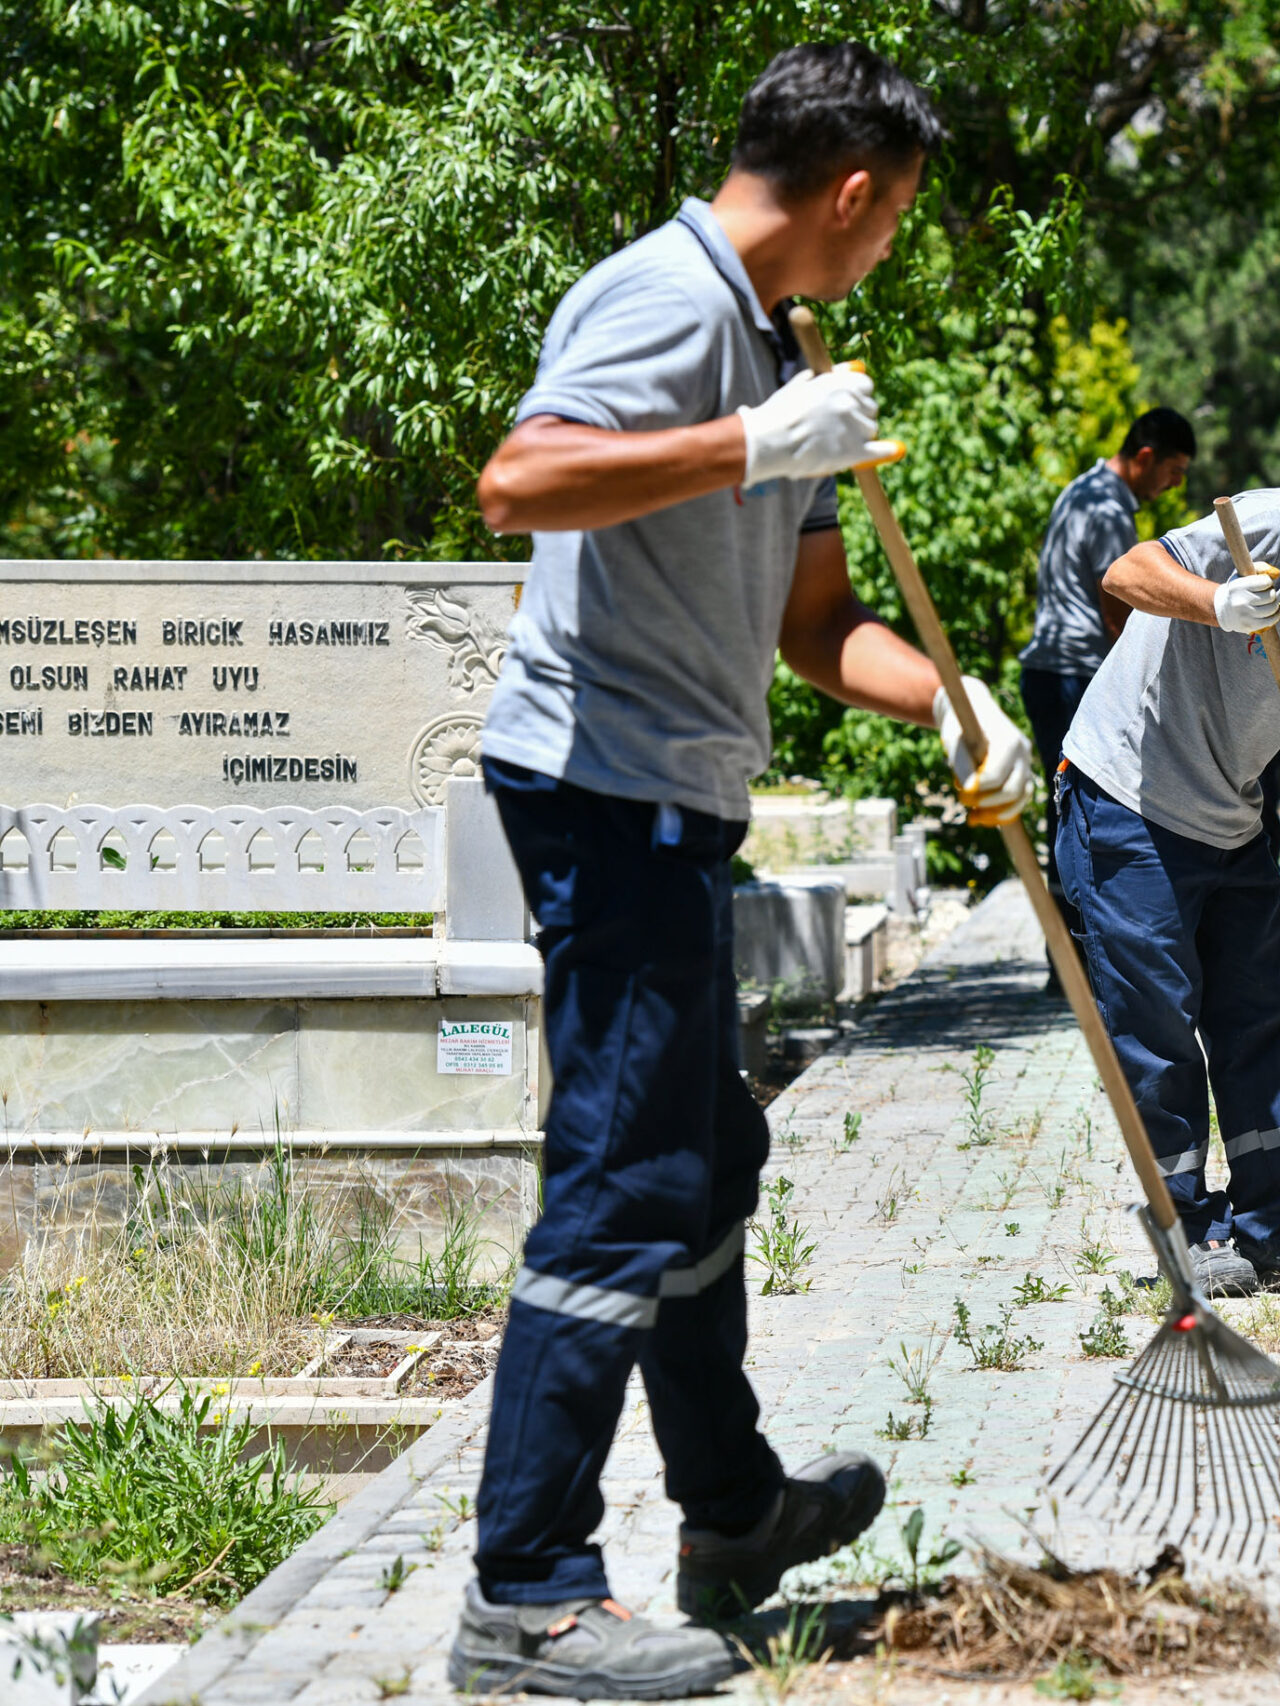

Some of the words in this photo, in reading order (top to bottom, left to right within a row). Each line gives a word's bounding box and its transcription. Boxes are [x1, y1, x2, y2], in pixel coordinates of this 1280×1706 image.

[0, 616, 137, 648] MSÜZLEŞEN
[162, 616, 244, 646] BİRİCİK
[268, 620, 390, 646] HASANIMIZ
[10, 665, 88, 691] OLSUN
[113, 665, 188, 691] RAHAT
[212, 665, 259, 692] UYU
[0, 707, 43, 736] ENİ
[68, 707, 153, 737] BİZDEN
[178, 711, 291, 737] AYIRAMAZ
[222, 752, 357, 786] İÇİMİZDESİN
[441, 1023, 511, 1039] LALEGÜL
